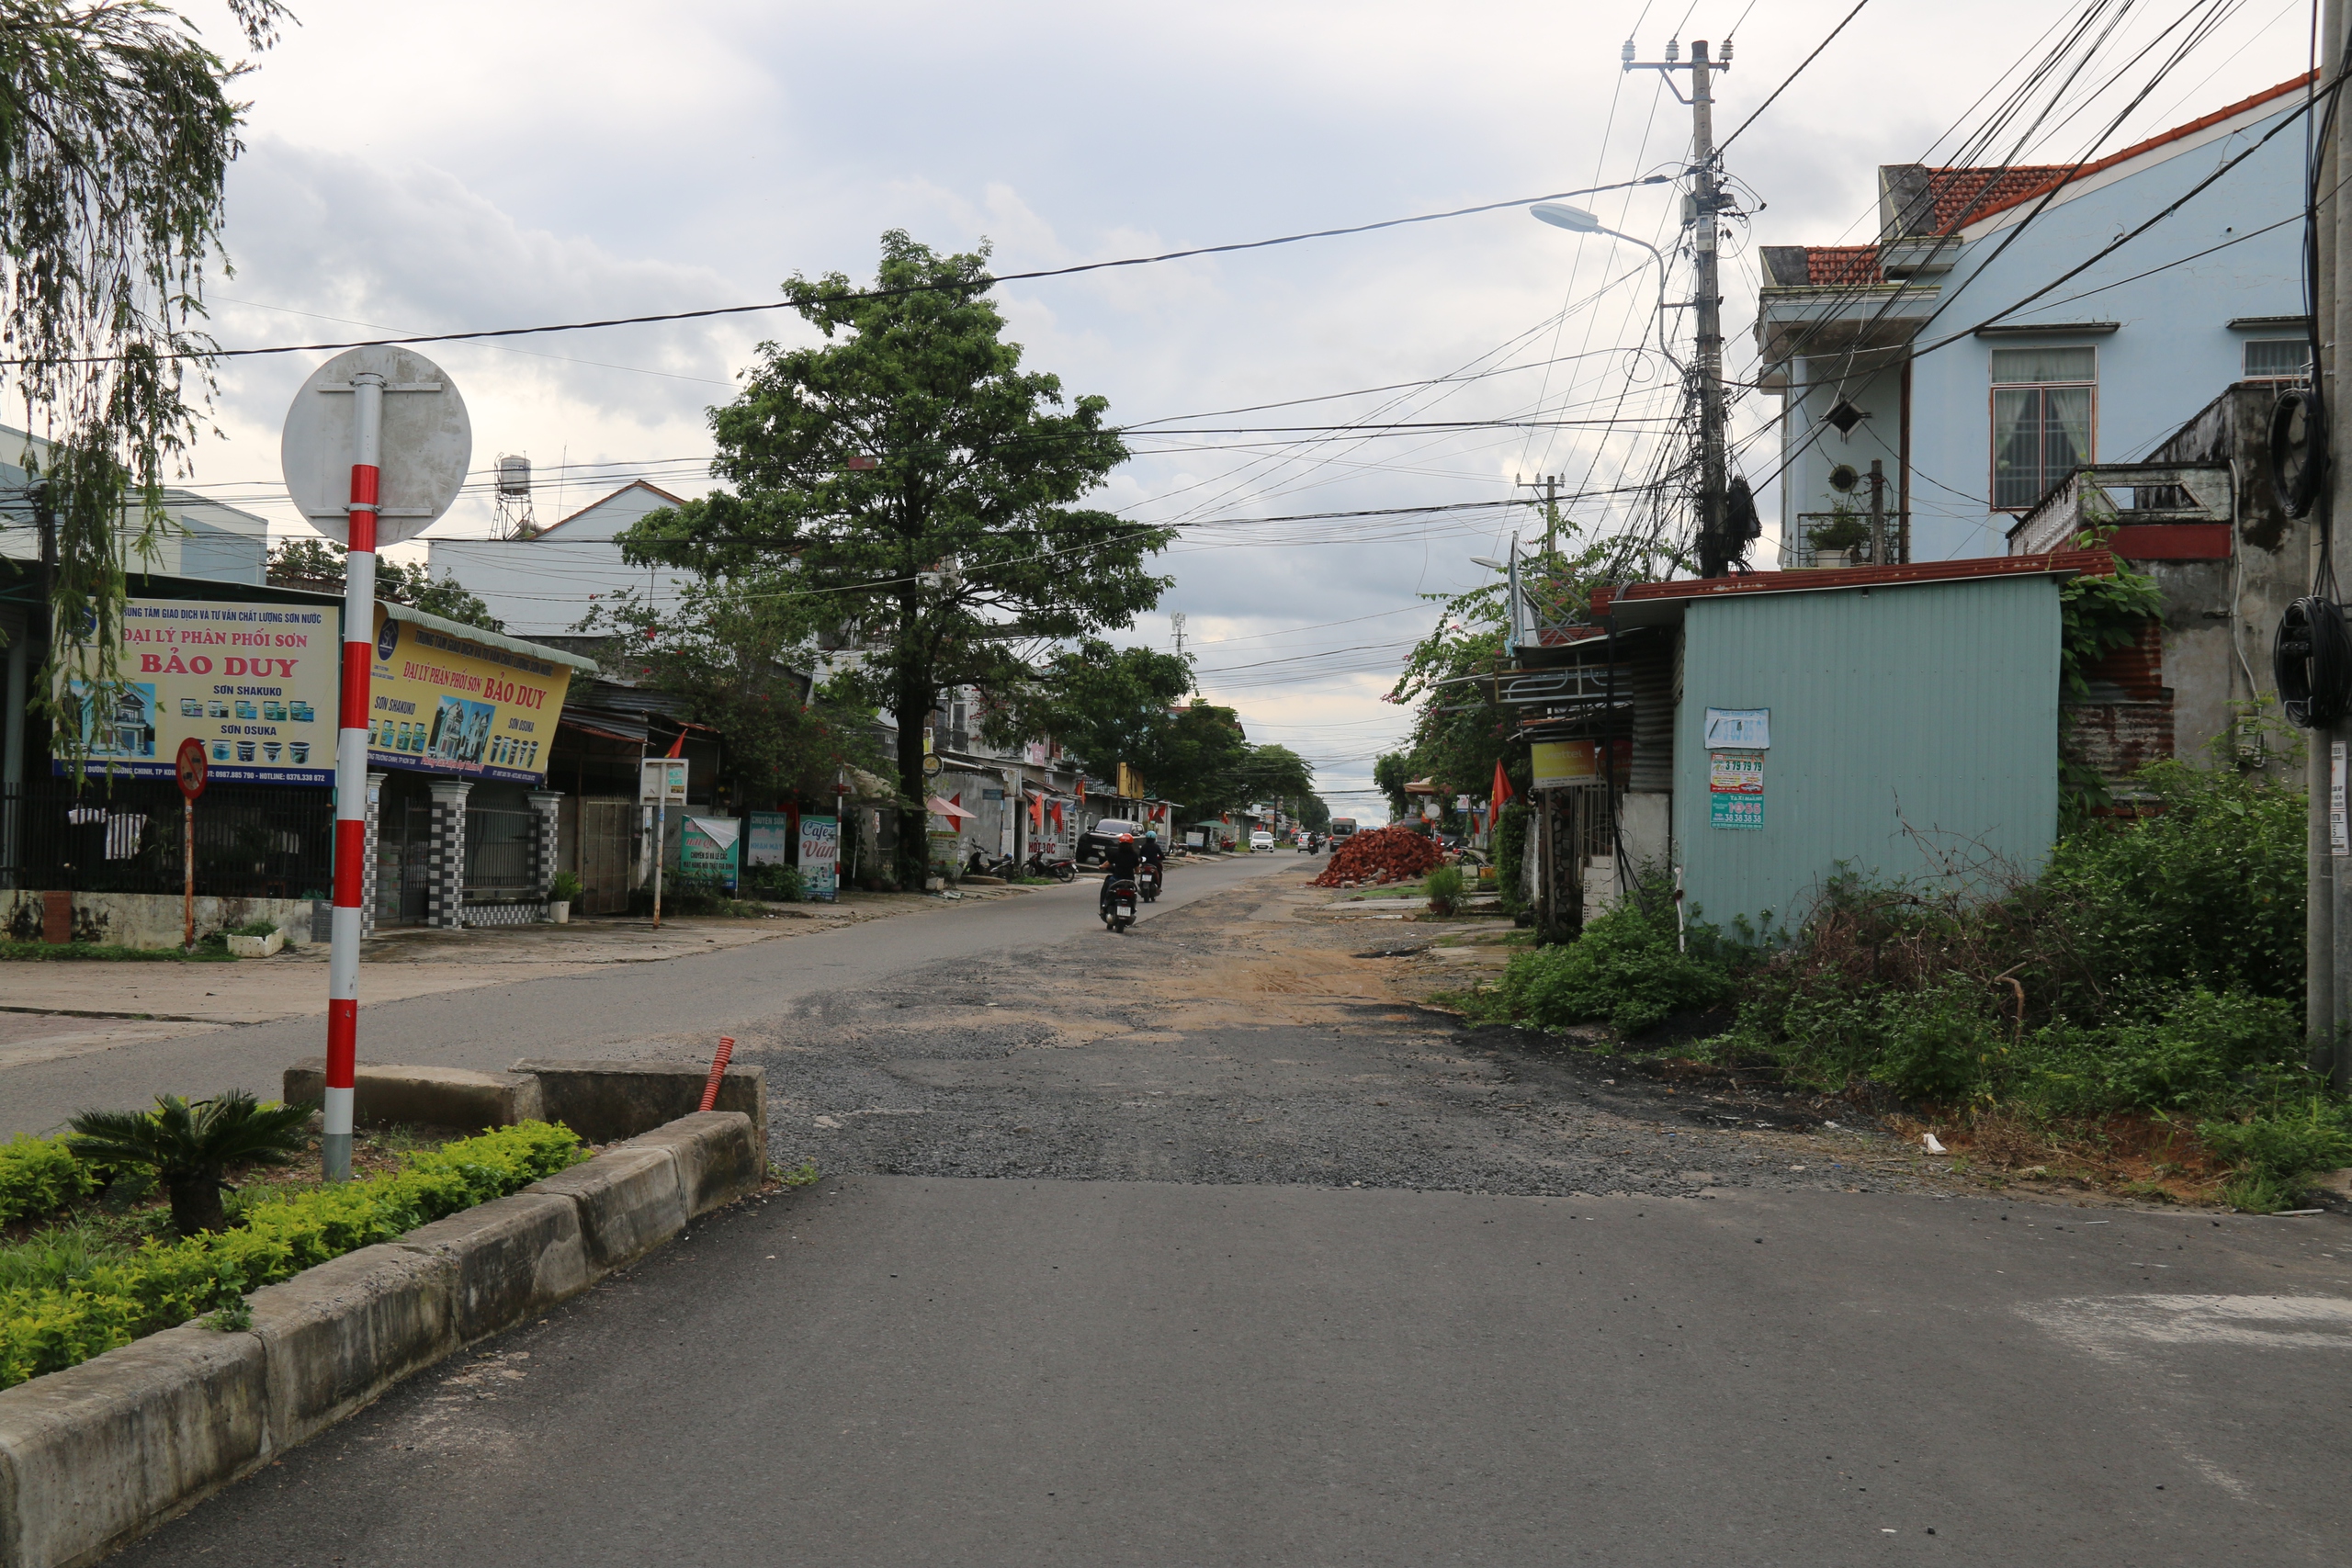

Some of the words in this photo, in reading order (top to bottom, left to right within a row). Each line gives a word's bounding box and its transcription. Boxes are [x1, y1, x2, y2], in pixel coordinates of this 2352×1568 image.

[120, 606, 142, 617] RUNG
[144, 606, 160, 618] TÂM
[162, 609, 178, 619] GIAO
[181, 609, 198, 621] DỊCH
[199, 608, 209, 620] VÀ
[211, 610, 220, 620] TƯ
[222, 608, 236, 621] VẤN
[239, 609, 257, 622] CHẤT
[258, 611, 282, 624] LƯỢNG
[285, 612, 300, 623] SƠN
[301, 612, 322, 624] NƯỚC
[124, 628, 151, 645] ĐẠI
[155, 626, 176, 643] LÝ
[181, 627, 227, 645] PHÂN
[232, 627, 270, 647] PHỐI
[275, 632, 308, 648] SƠN
[140, 647, 213, 675] BẢO
[223, 657, 300, 678] DUY
[213, 685, 233, 694] SƠN
[237, 686, 282, 696] SHAKUKO
[403, 660, 419, 682] ĐẠI
[419, 661, 430, 682] LÝ
[429, 665, 450, 686] PHÂN
[449, 667, 468, 690] PHỐI
[467, 675, 482, 693] SƠN
[482, 671, 514, 704] BẢO
[515, 683, 548, 710] DUY
[374, 695, 390, 710] SƠN
[388, 698, 416, 716] SHAKUKO
[220, 725, 241, 735] SƠN
[244, 726, 277, 736] OSUKA
[1543, 750, 1583, 760] viettel
[1733, 761, 1741, 771] 79
[1744, 761, 1752, 771] 79
[1754, 761, 1762, 771] 79
[752, 816, 772, 825] CHUYÊN
[802, 840, 835, 858] Vân
